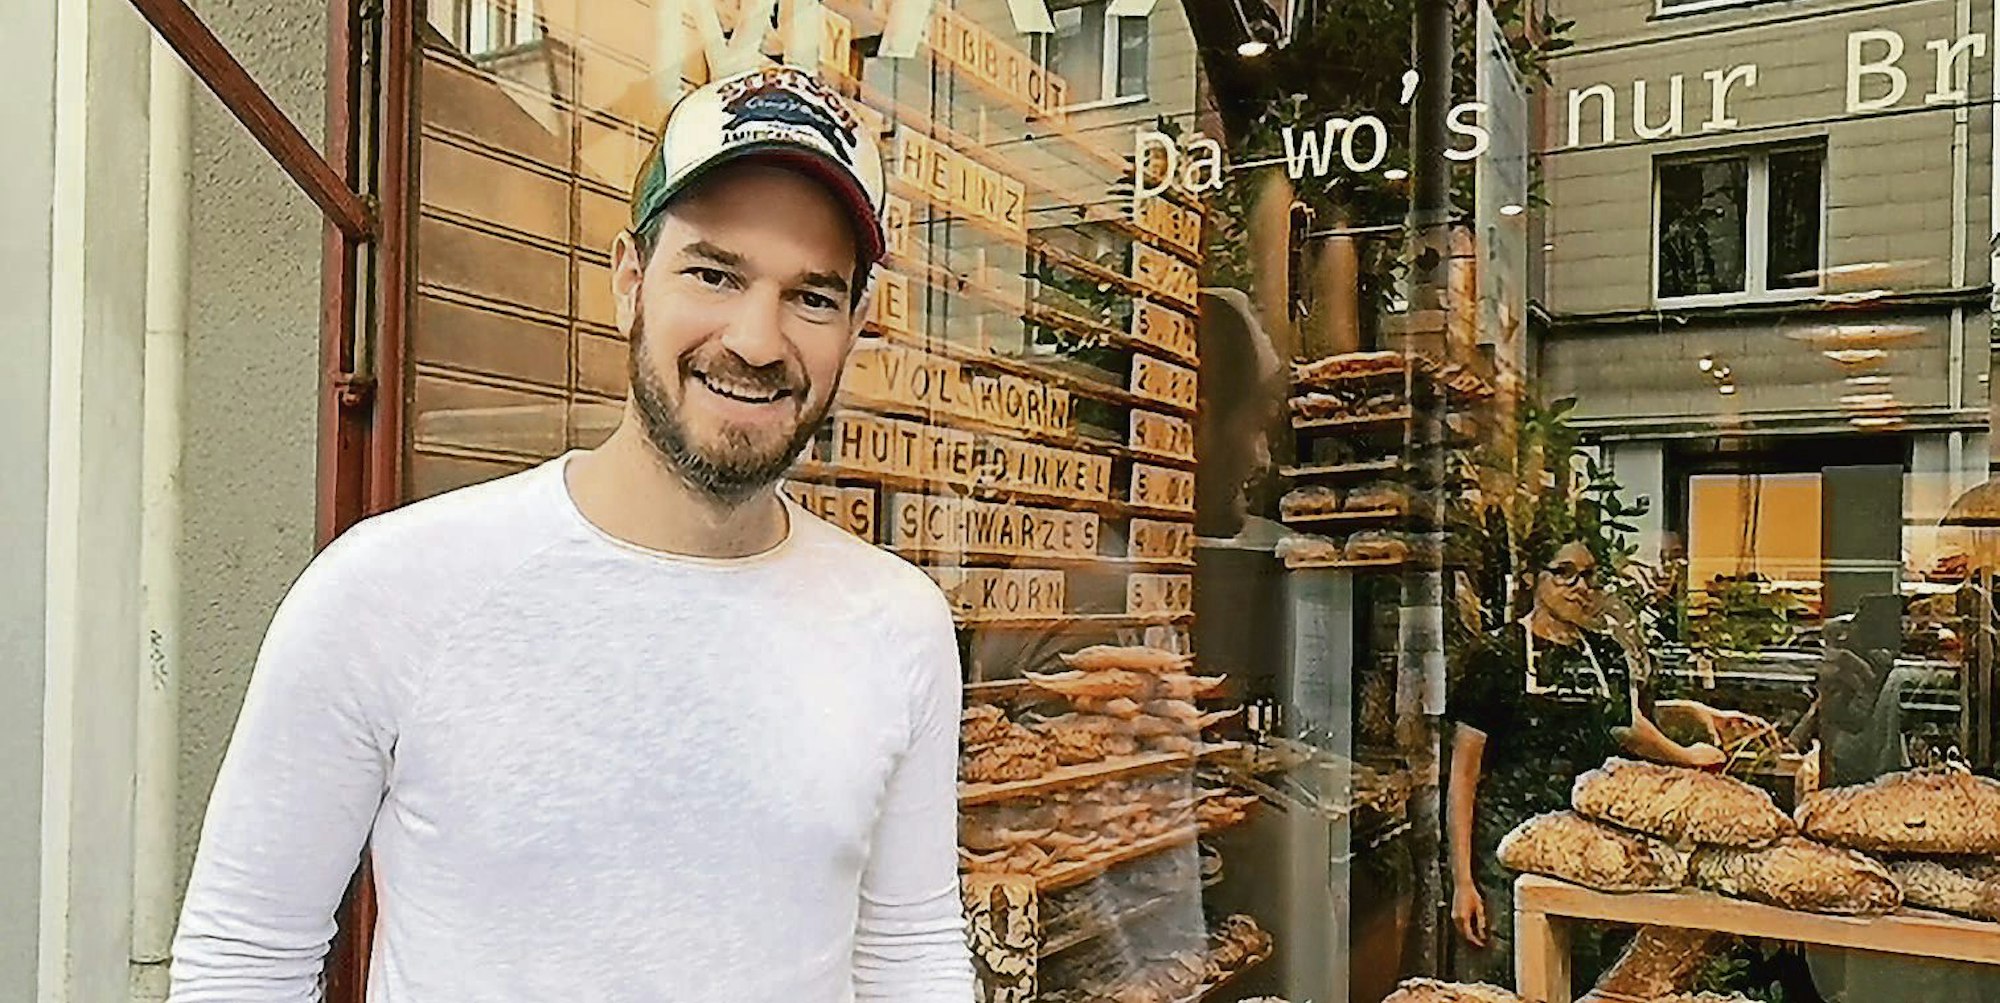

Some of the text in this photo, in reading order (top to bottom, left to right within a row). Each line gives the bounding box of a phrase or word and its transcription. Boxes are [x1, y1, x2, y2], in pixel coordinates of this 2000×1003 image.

[1134, 128, 1225, 198] Da
[1567, 63, 1758, 147] nur
[903, 140, 1019, 224] HEINZ
[900, 504, 1096, 550] SCHWARZES
